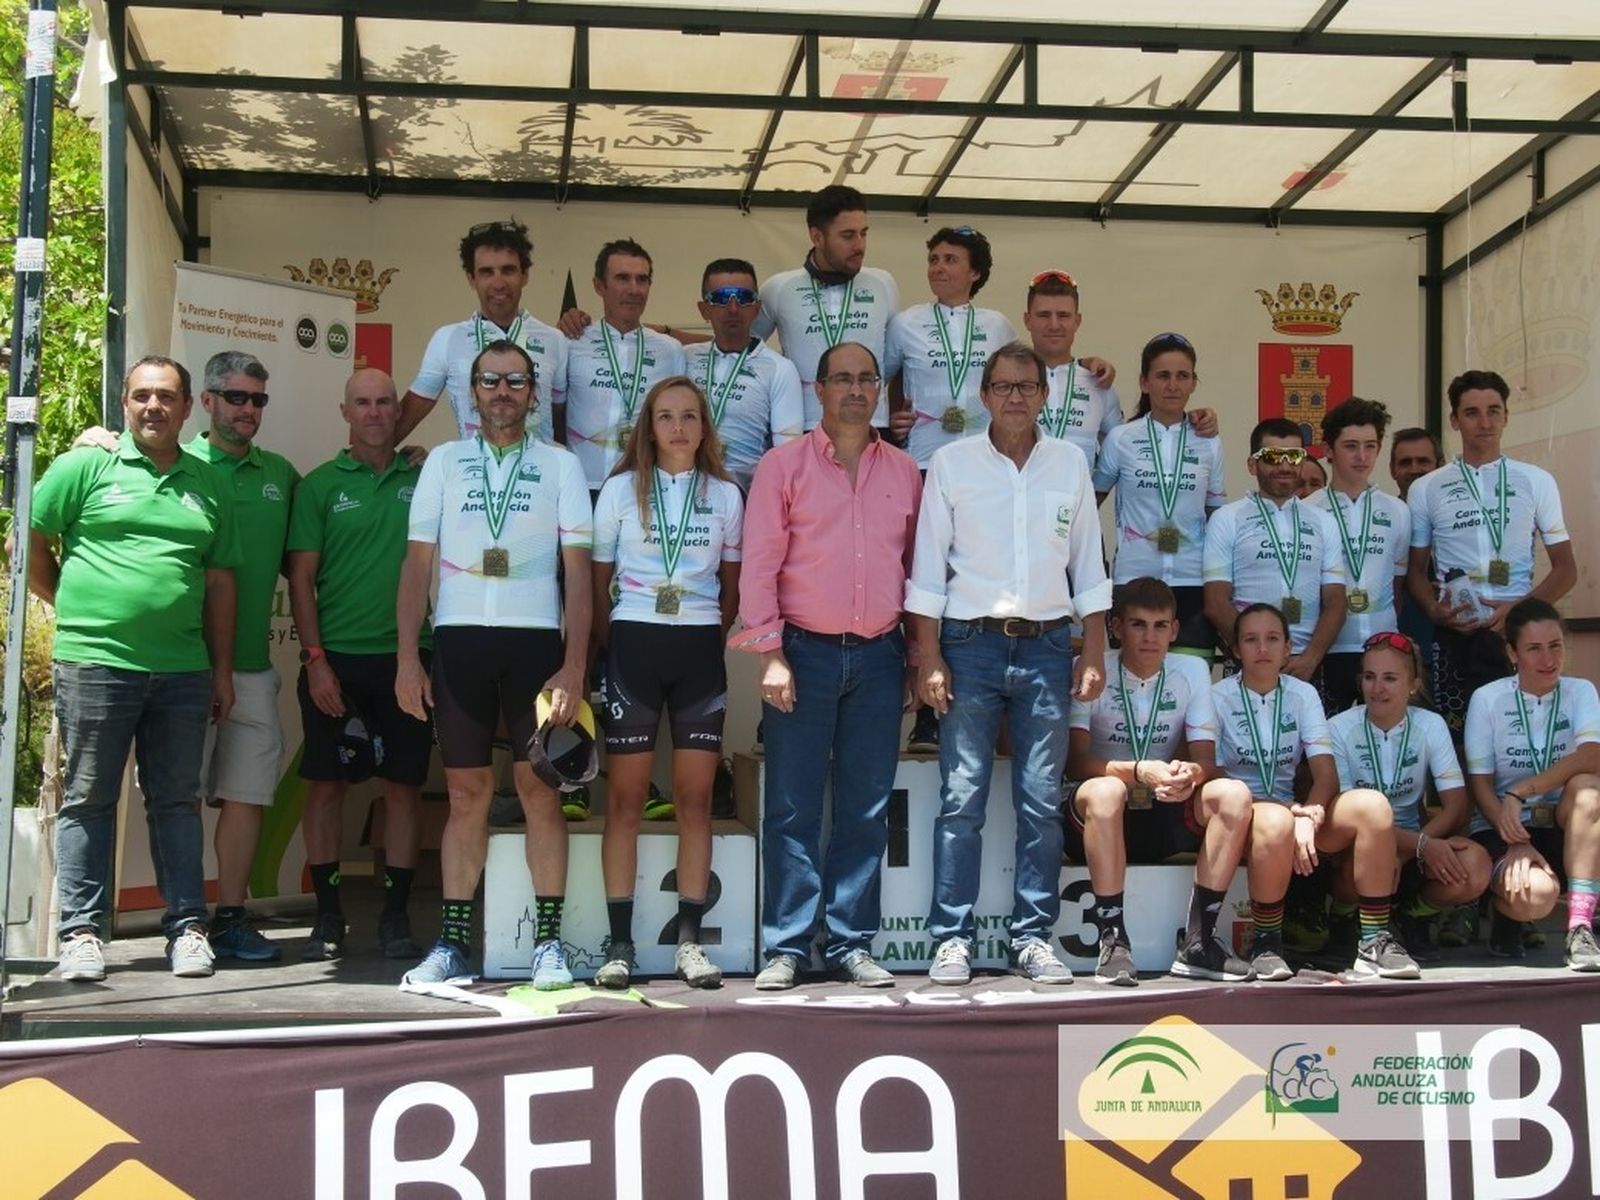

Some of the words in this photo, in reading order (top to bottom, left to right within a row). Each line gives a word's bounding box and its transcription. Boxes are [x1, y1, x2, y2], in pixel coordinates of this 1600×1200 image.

[180, 318, 225, 336] Movimiento
[188, 304, 217, 319] Partner
[219, 308, 258, 325] Energético
[259, 316, 276, 329] para
[277, 319, 284, 329] el
[658, 867, 722, 945] 2
[1059, 879, 1100, 958] 3
